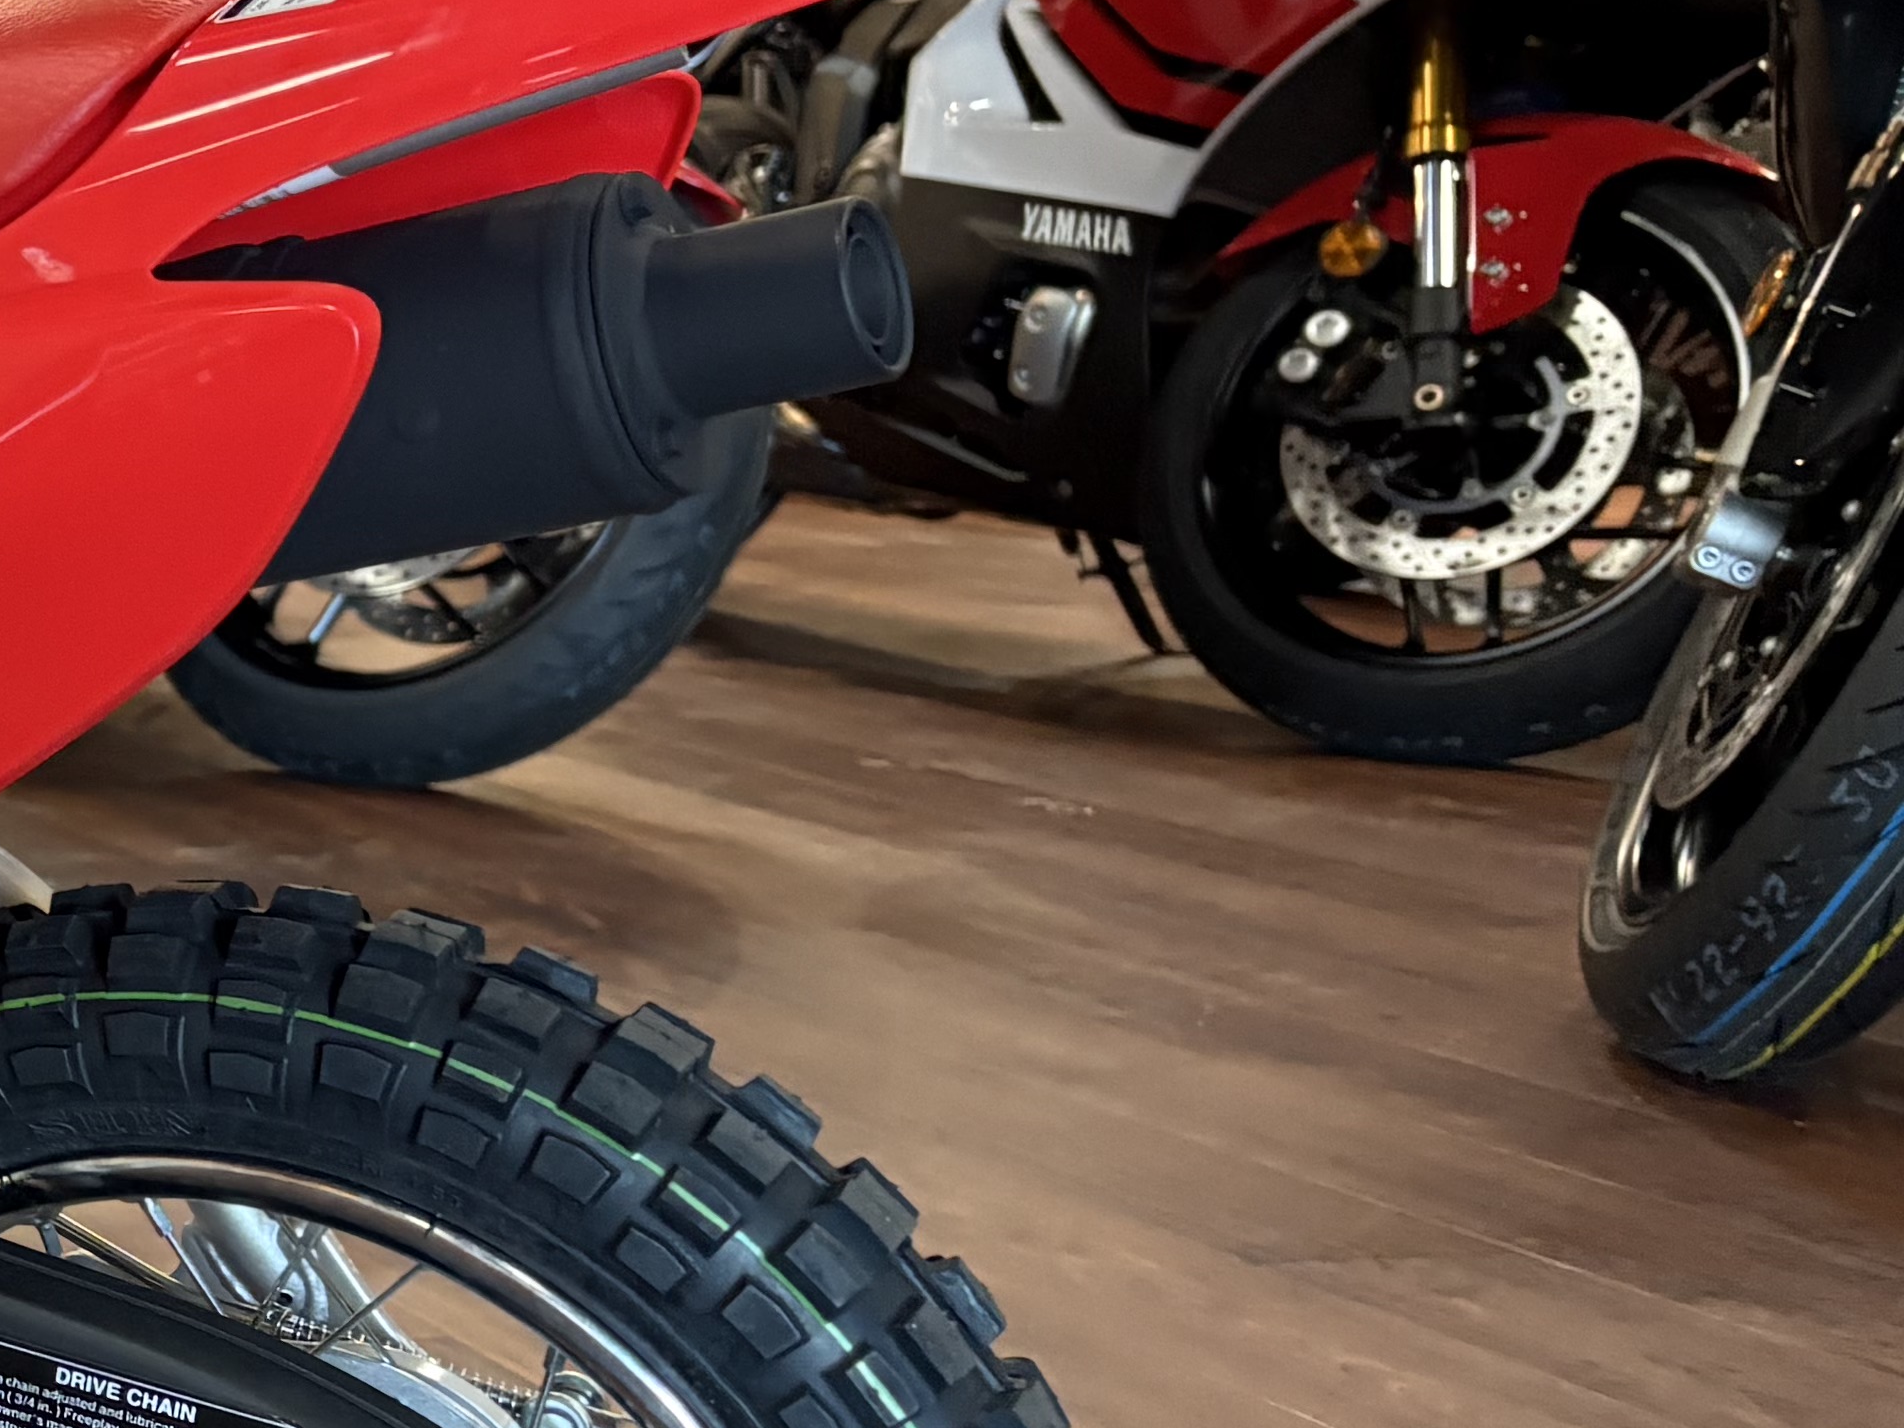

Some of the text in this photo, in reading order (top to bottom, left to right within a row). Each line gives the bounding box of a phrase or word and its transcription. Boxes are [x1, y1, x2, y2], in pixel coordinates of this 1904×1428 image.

[1021, 201, 1133, 257] YAMAHA
[5, 1376, 40, 1395] chain
[41, 1388, 97, 1412] adjusted
[98, 1404, 124, 1421] and
[13, 1392, 35, 1408] 3/4
[55, 1366, 197, 1423] DRIVE CHAIN
